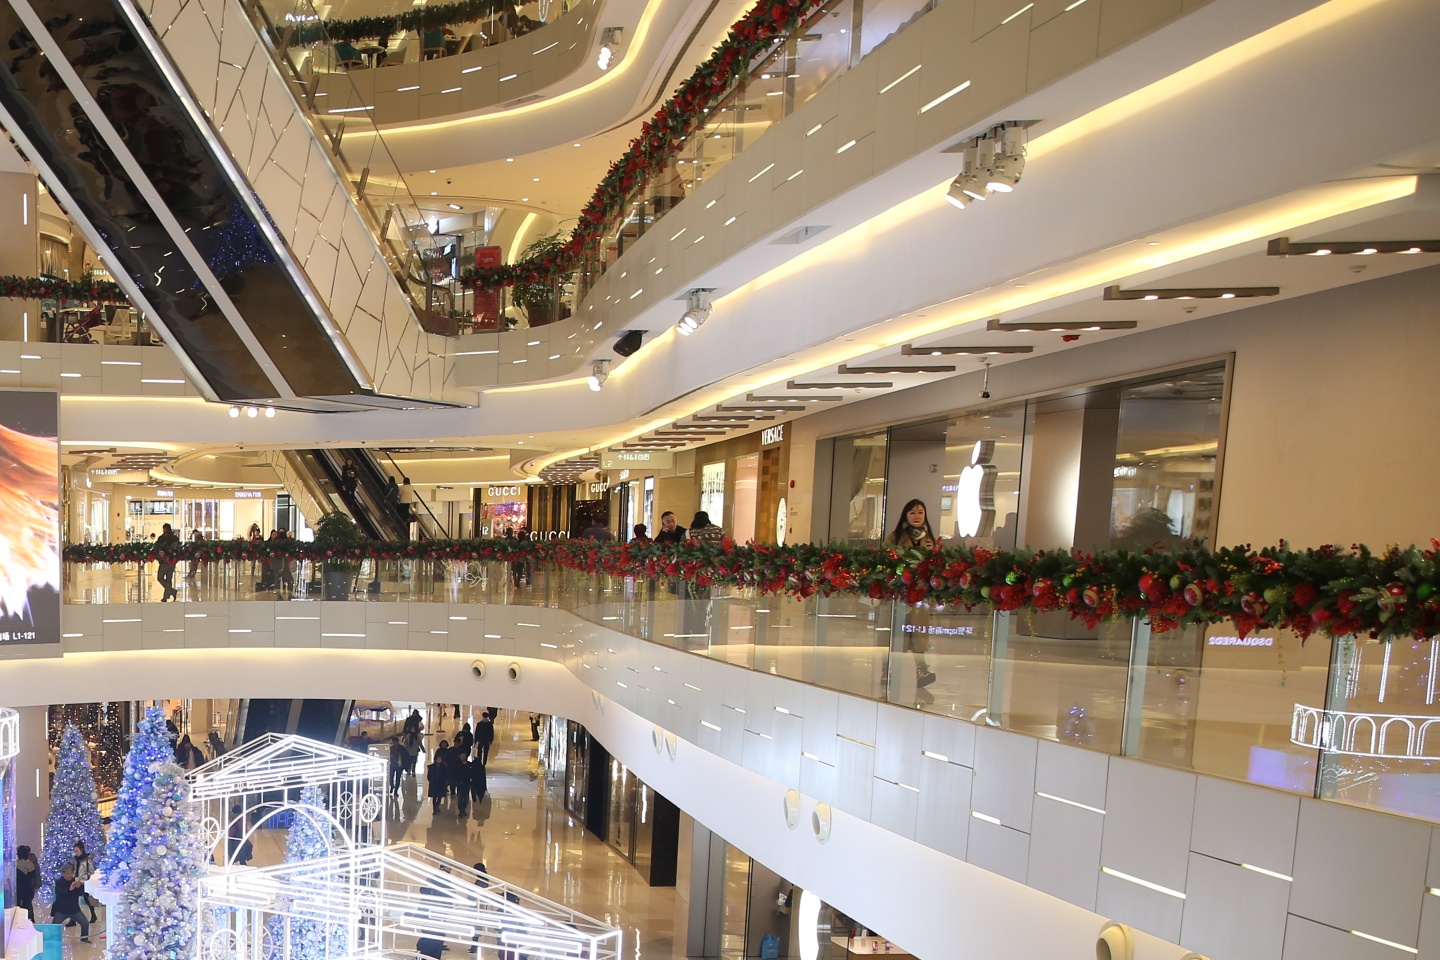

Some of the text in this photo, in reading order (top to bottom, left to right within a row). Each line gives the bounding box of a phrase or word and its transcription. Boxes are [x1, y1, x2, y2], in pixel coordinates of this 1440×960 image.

[761, 424, 785, 446] VERSACE
[487, 486, 521, 497] GUCCI
[12, 631, 36, 640] L1-121
